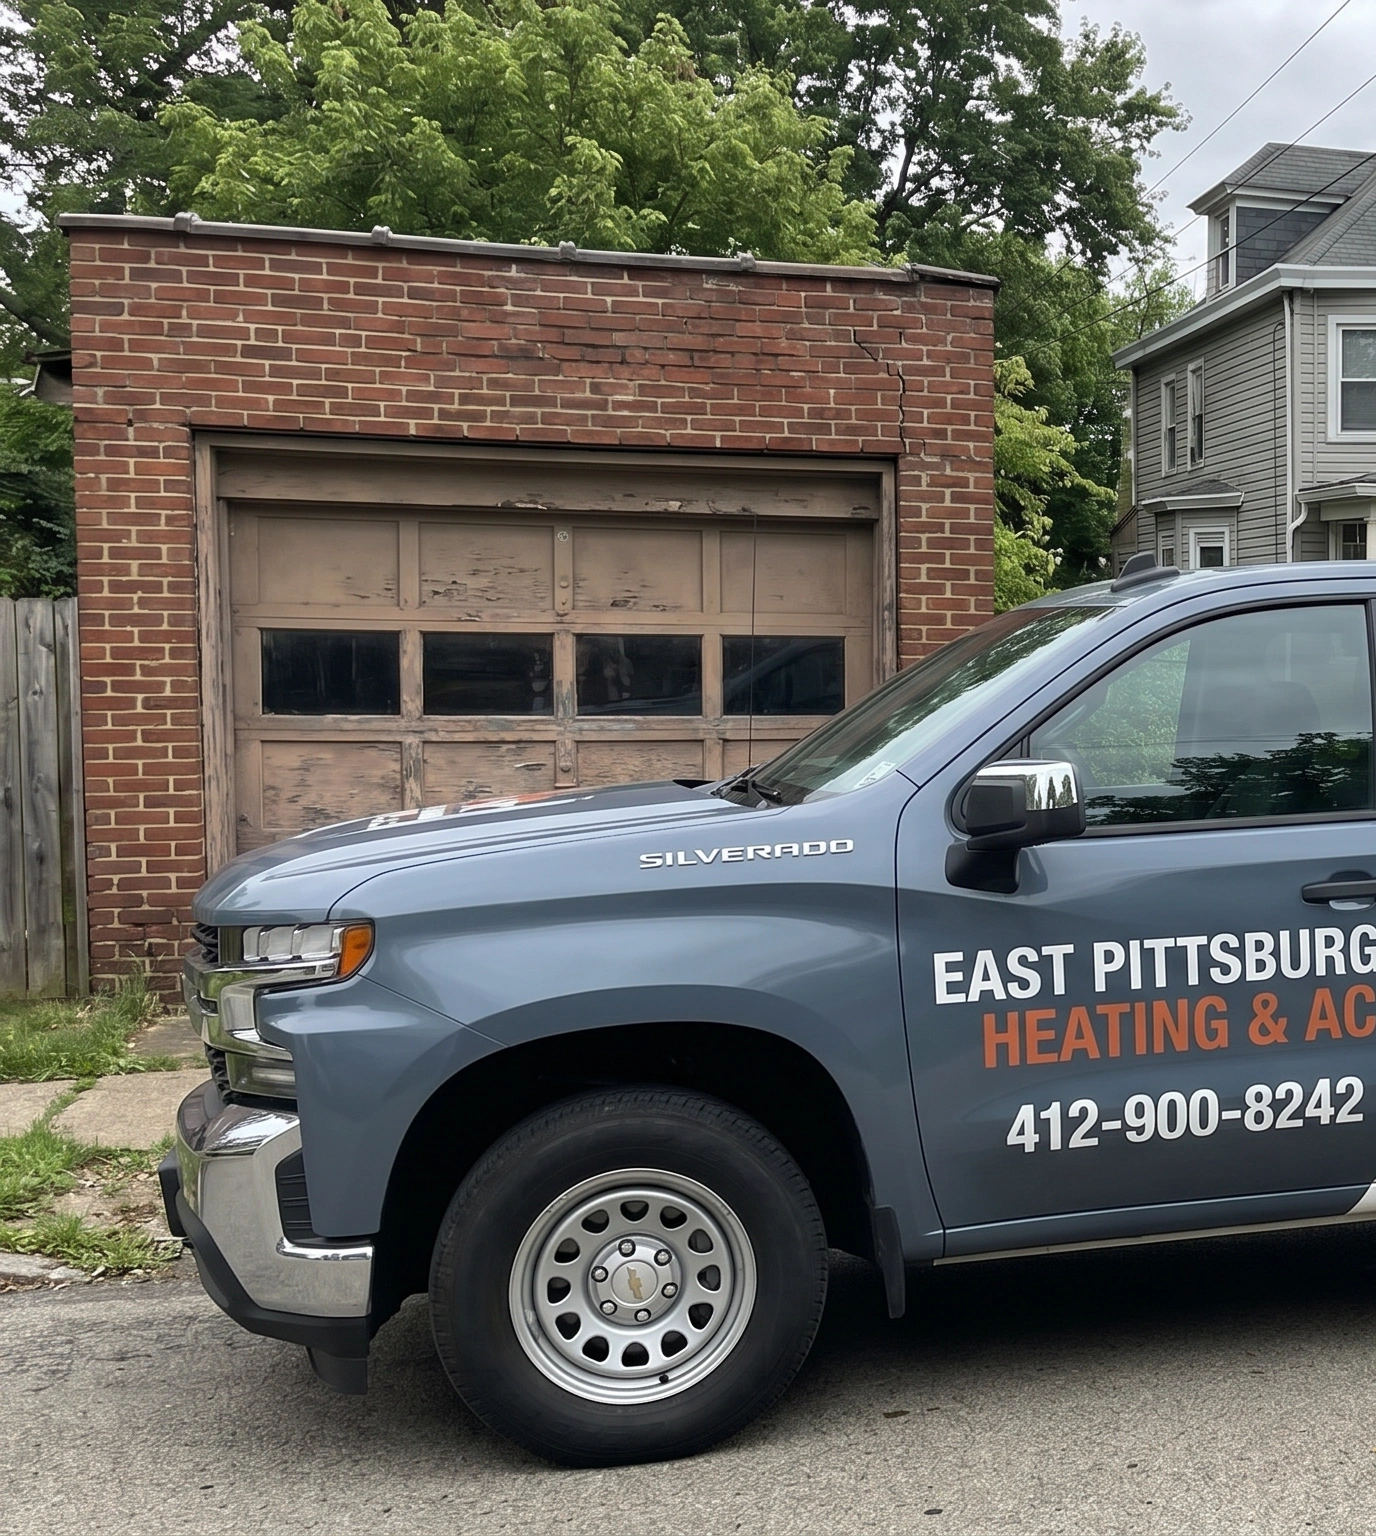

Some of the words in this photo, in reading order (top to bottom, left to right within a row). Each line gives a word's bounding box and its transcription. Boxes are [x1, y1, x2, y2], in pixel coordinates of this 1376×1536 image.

[638, 838, 856, 869] SILVERADO
[933, 943, 1075, 1005] EAST
[984, 996, 1228, 1067] HEATING
[1249, 992, 1288, 1045] &
[1006, 1076, 1365, 1153] 412-900-8242
